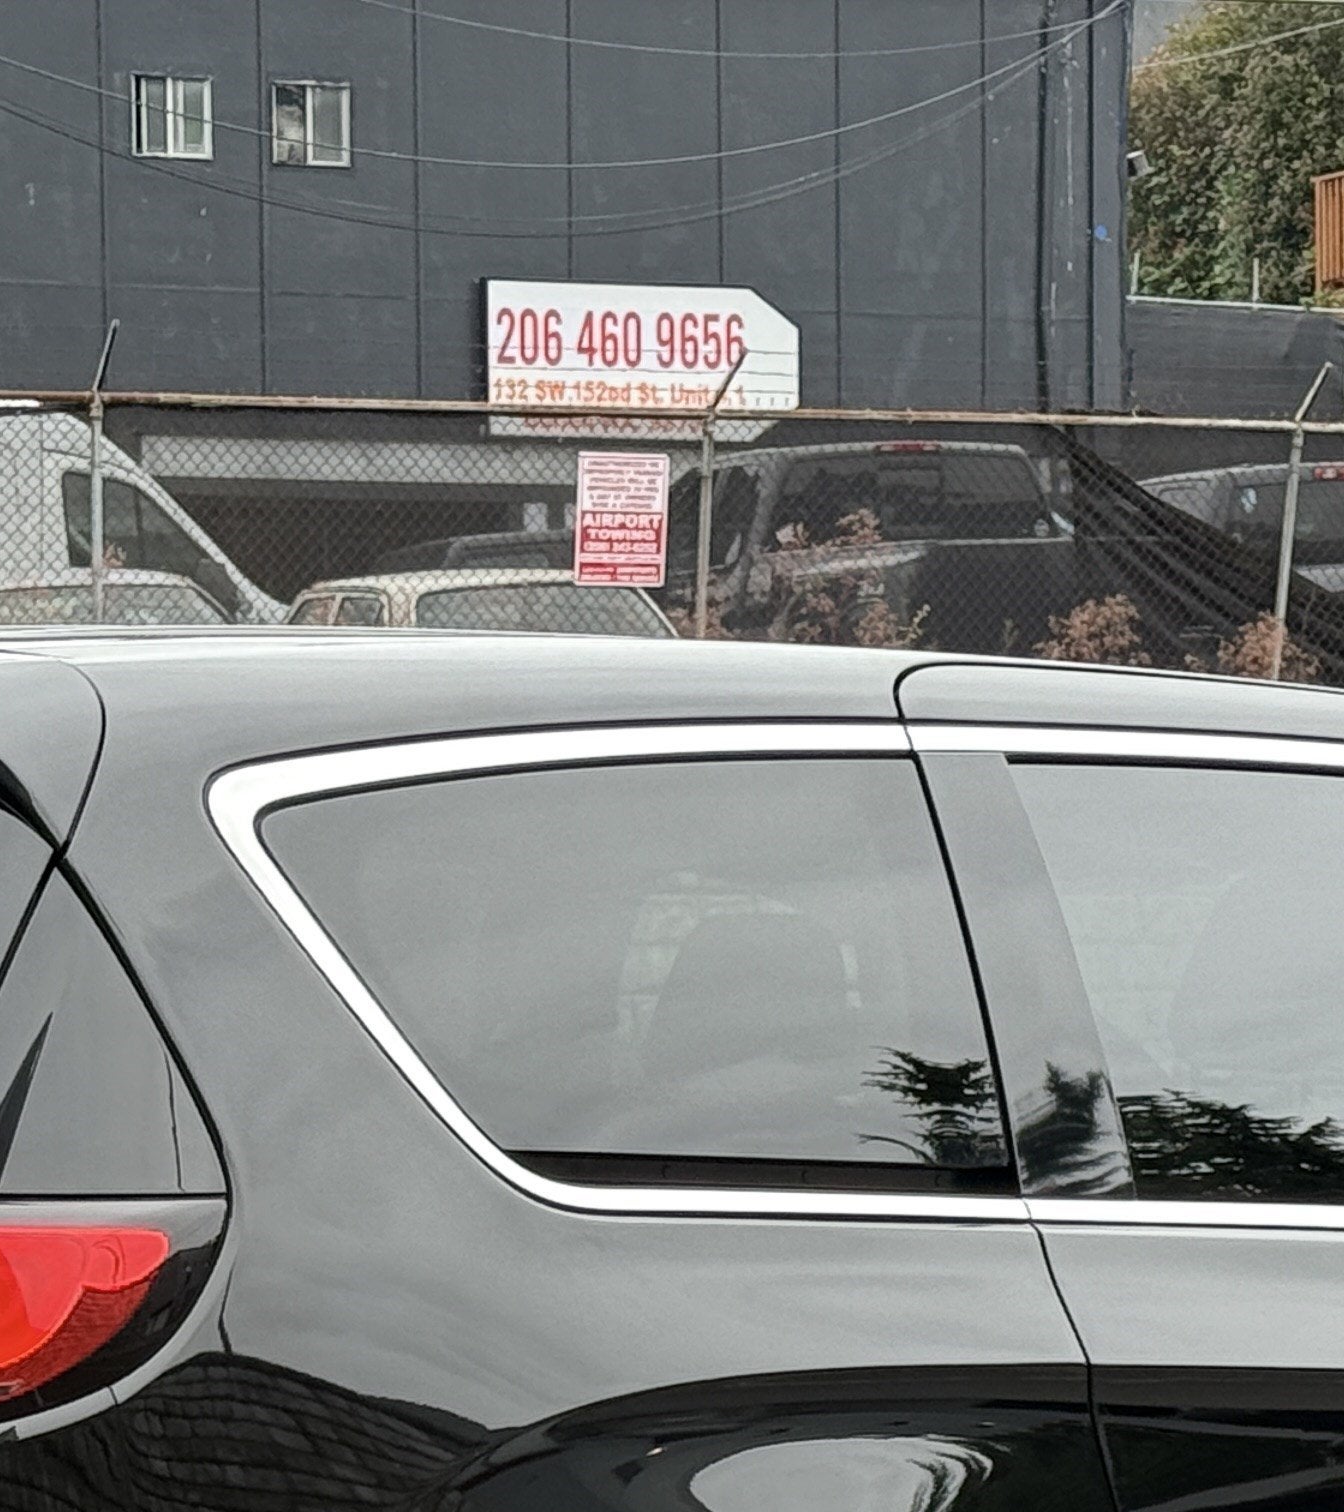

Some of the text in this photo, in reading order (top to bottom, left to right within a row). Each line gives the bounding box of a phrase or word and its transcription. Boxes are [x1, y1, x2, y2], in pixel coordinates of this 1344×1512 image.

[496, 307, 746, 370] 206 460 9656
[493, 378, 529, 402] 132
[582, 512, 663, 529] AIRPORT
